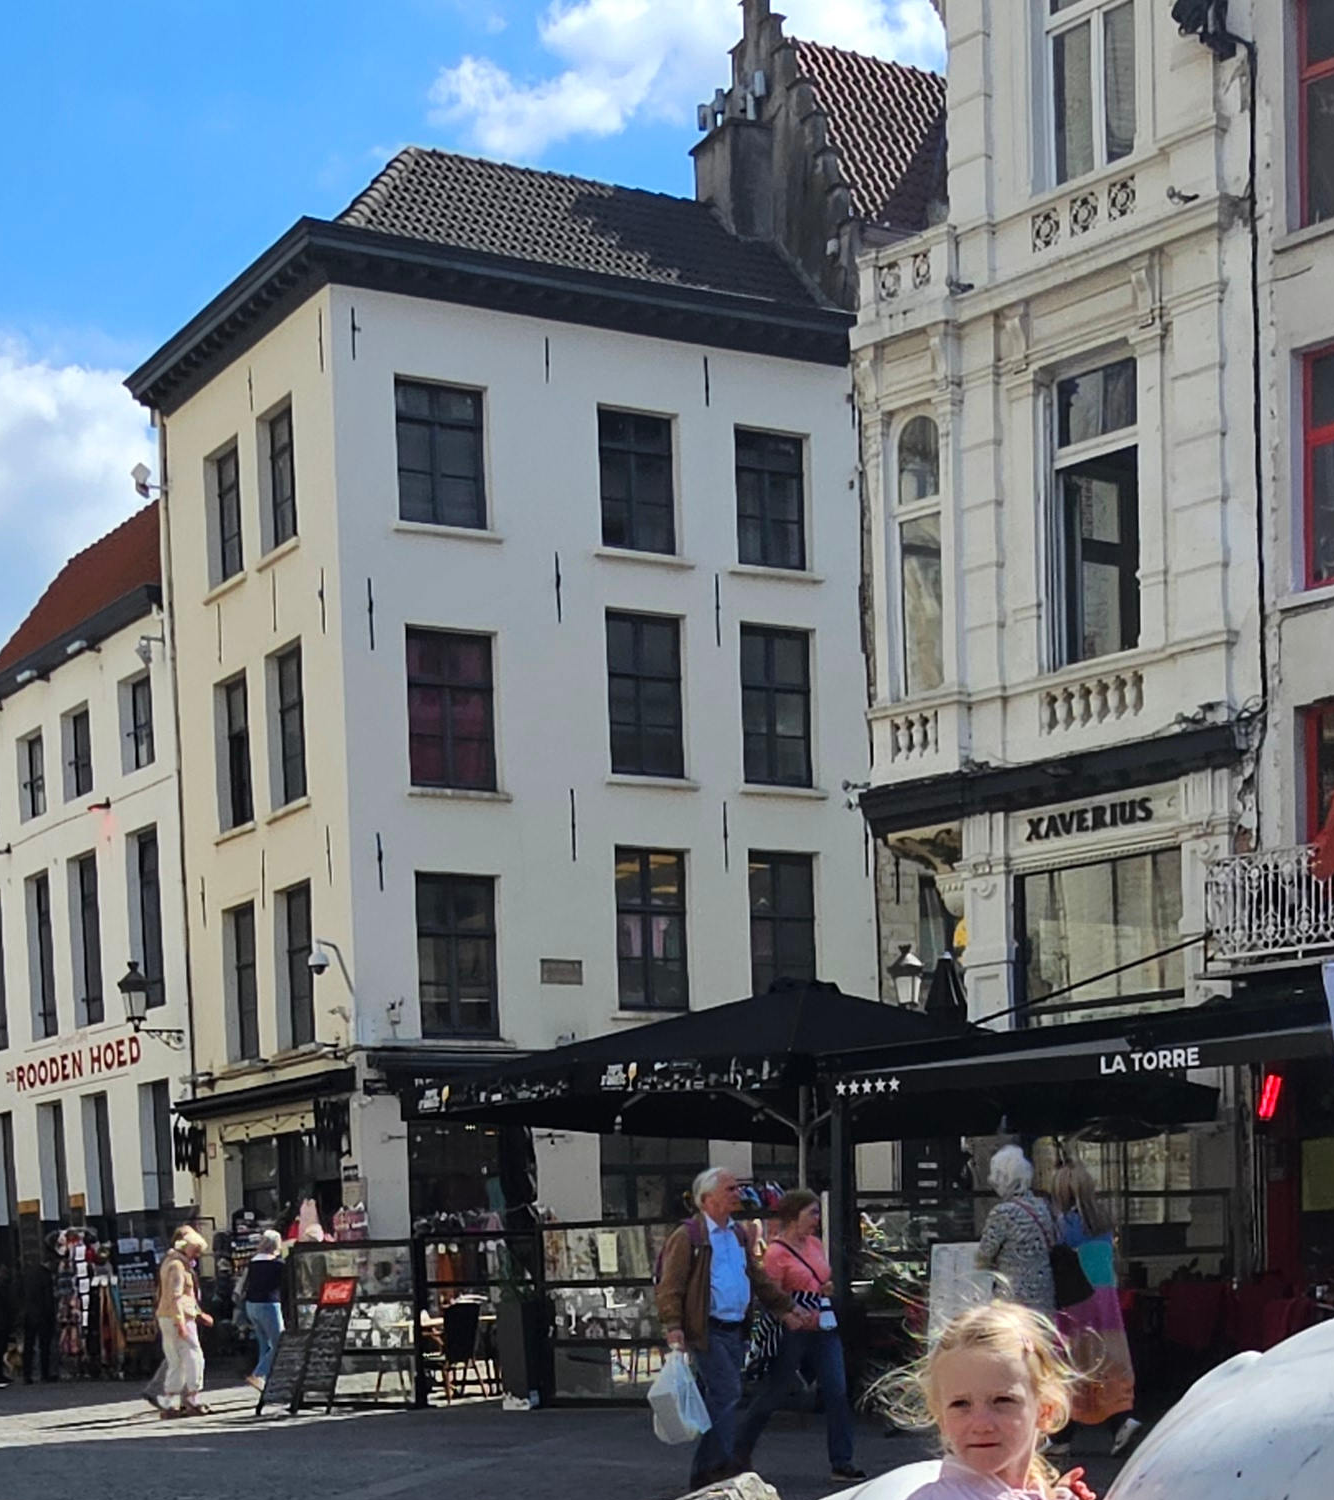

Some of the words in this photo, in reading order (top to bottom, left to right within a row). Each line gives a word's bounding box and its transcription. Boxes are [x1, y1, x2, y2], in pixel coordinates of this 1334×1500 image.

[1025, 797, 1154, 842] XAVERIUS
[16, 1050, 83, 1092] ROODEN
[89, 1035, 142, 1075] HOED
[1100, 1054, 1127, 1075] LA
[1129, 1046, 1201, 1072] TORRE
